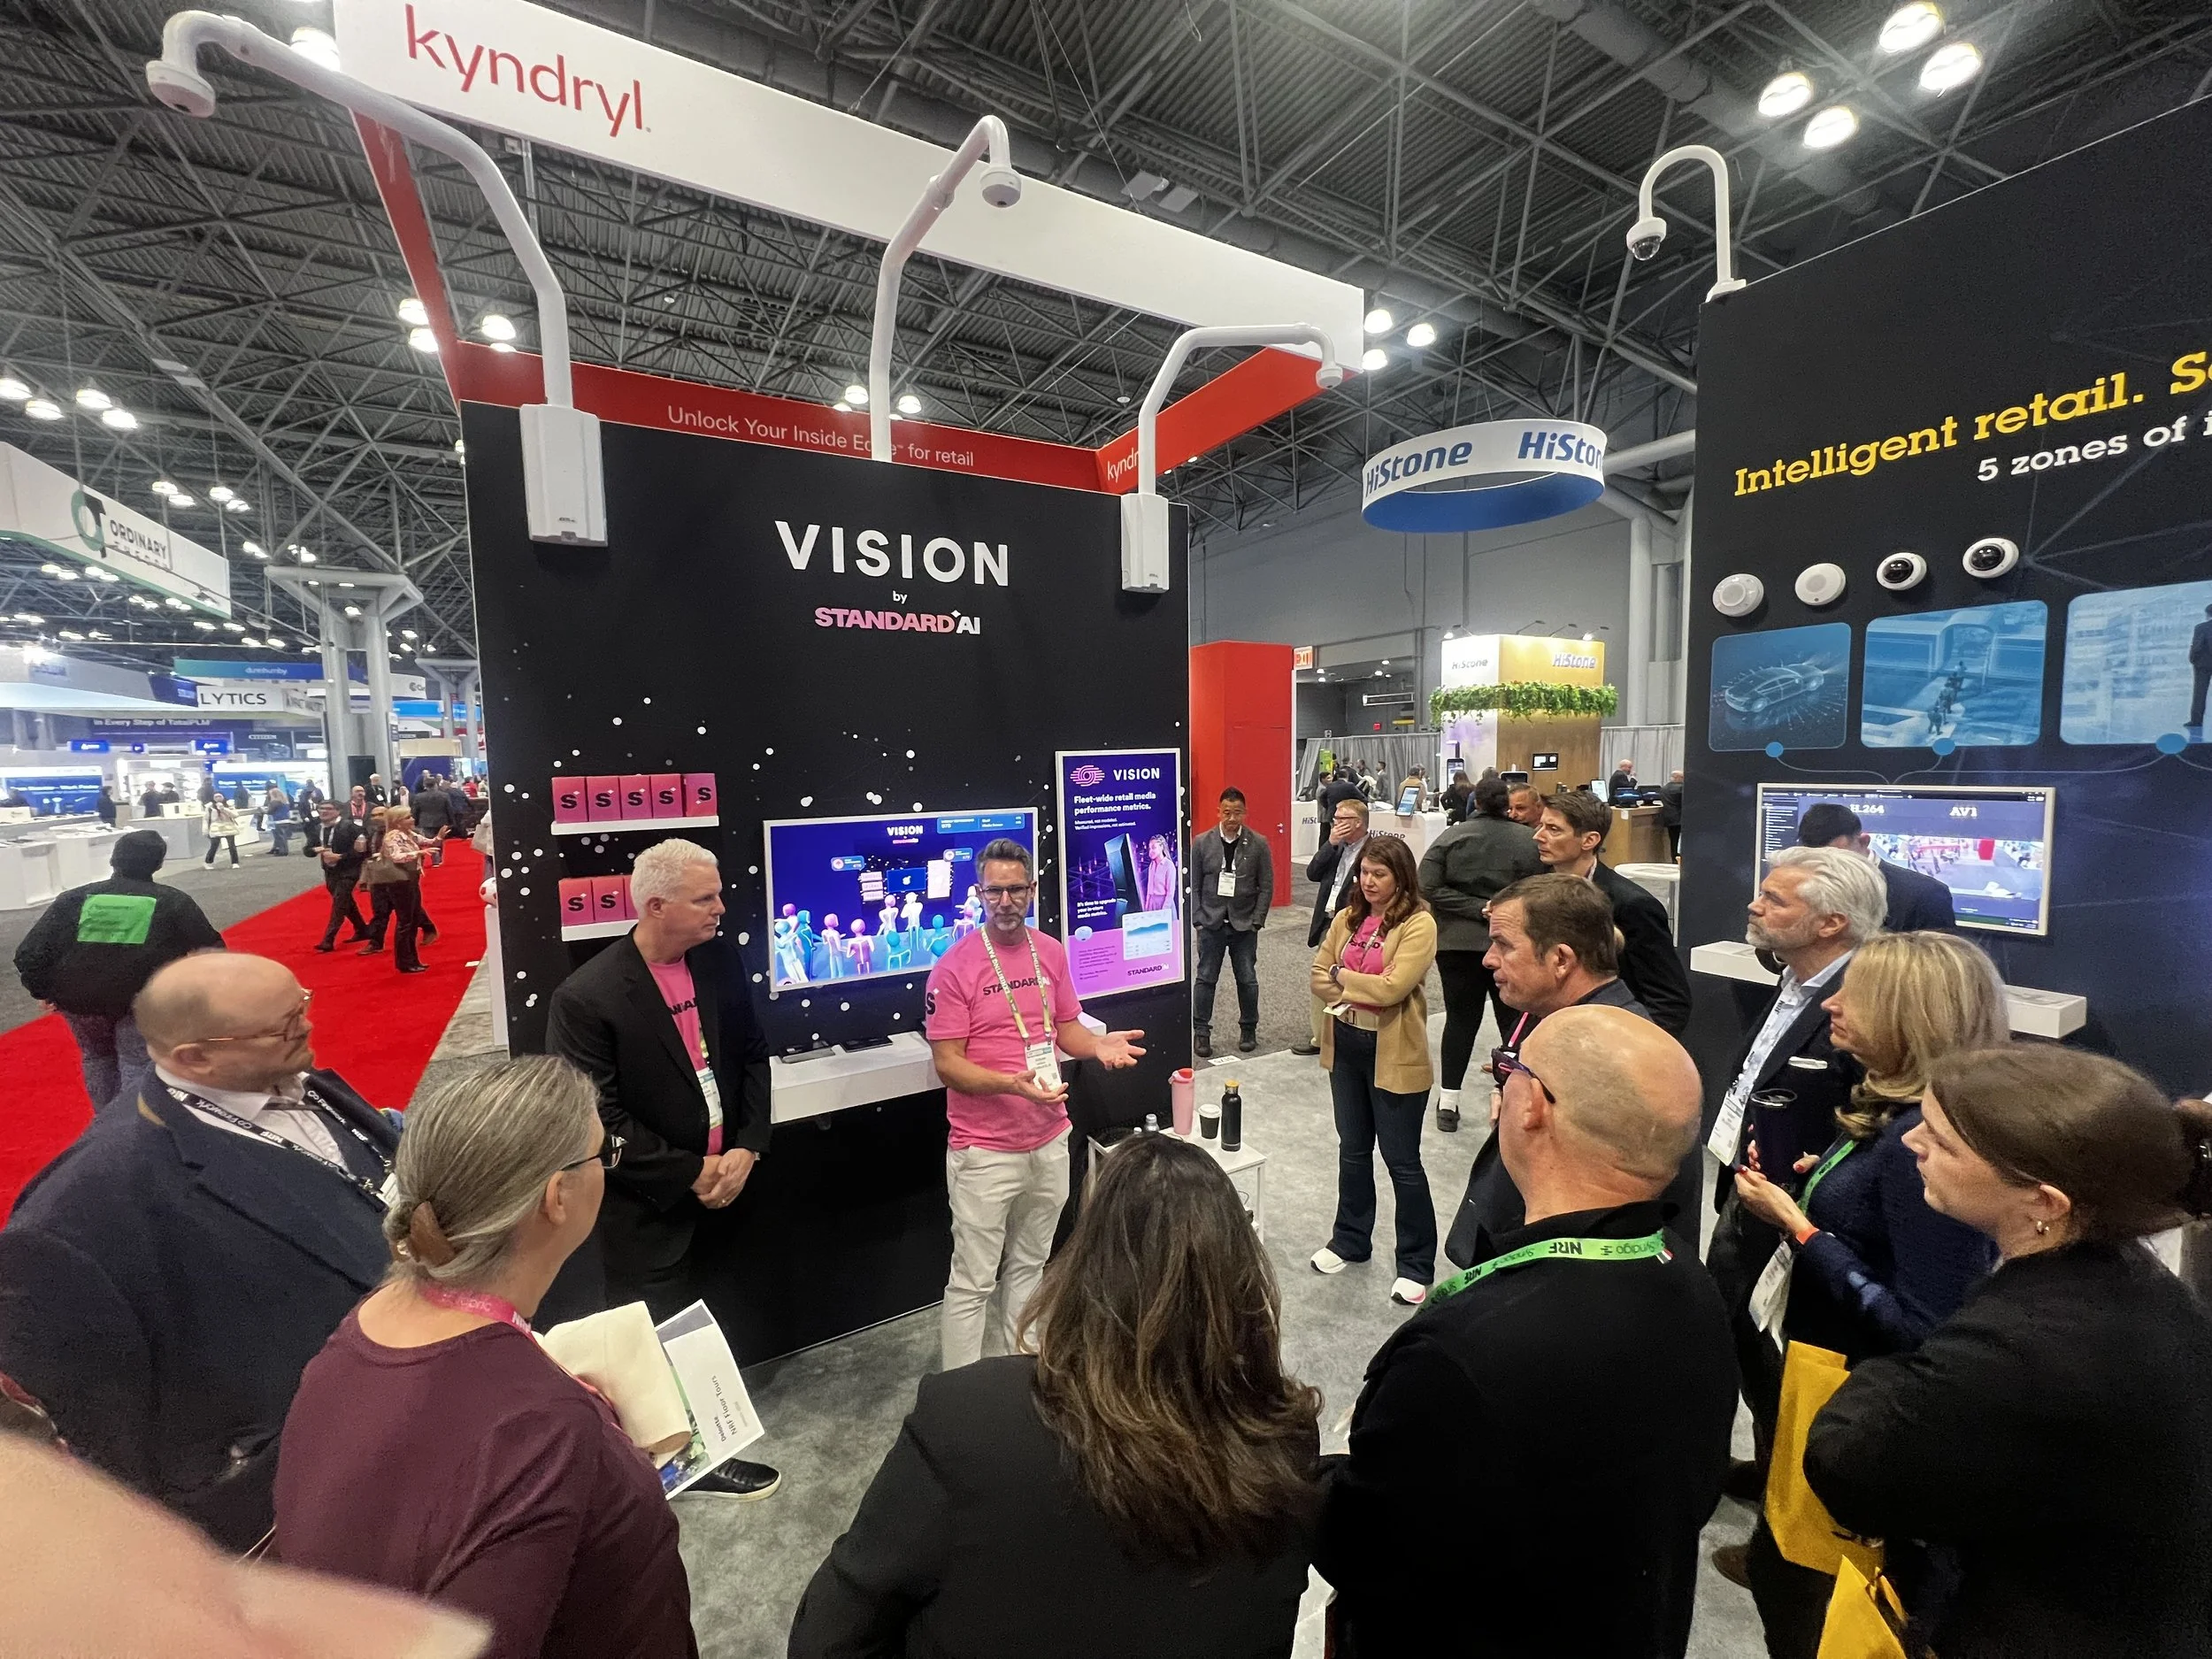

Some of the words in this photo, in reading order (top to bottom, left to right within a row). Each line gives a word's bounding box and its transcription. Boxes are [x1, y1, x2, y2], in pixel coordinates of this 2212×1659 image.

[668, 405, 739, 433] Unlock
[744, 417, 787, 439] Your
[794, 426, 848, 449] Inside
[908, 444, 930, 460] for
[935, 451, 975, 466] retail
[1734, 416, 1957, 495] Intelligent
[1974, 372, 2144, 441] retail.
[1517, 431, 1603, 469] HiSton
[1978, 458, 1999, 481] 5
[2010, 434, 2128, 475] zones
[2143, 414, 2188, 447] of
[1107, 447, 1139, 483] kyndr
[1365, 442, 1472, 498] HiStone
[110, 519, 168, 559] ORDINARY
[775, 520, 1009, 587] VISION
[893, 590, 908, 603] by
[815, 607, 955, 634] STANDARD
[1451, 658, 1488, 670] HiStone
[1552, 653, 1596, 669] HiStone
[200, 693, 267, 705] LYTICS
[1113, 768, 1160, 781] VISION
[561, 794, 577, 809] S
[595, 793, 611, 807] S
[627, 791, 643, 806] S
[659, 790, 674, 804] S
[697, 787, 711, 801] S
[1073, 795, 1114, 803] Fleet-wide
[1115, 793, 1133, 802] retail
[1134, 791, 1156, 800] media
[1074, 805, 1121, 816] performance
[1122, 803, 1151, 811] metrics.
[1949, 806, 1978, 818] AV1
[887, 826, 924, 836] VISION
[568, 896, 584, 911] S
[601, 895, 617, 909] S
[1127, 964, 1162, 976] STANDARD
[317, 1097, 347, 1125] Firework
[1549, 1241, 1583, 1256] NRF
[1463, 1266, 1483, 1285] NRF
[710, 1374, 724, 1398] Tours
[718, 1397, 731, 1419] Floor
[726, 1419, 738, 1436] NRF
